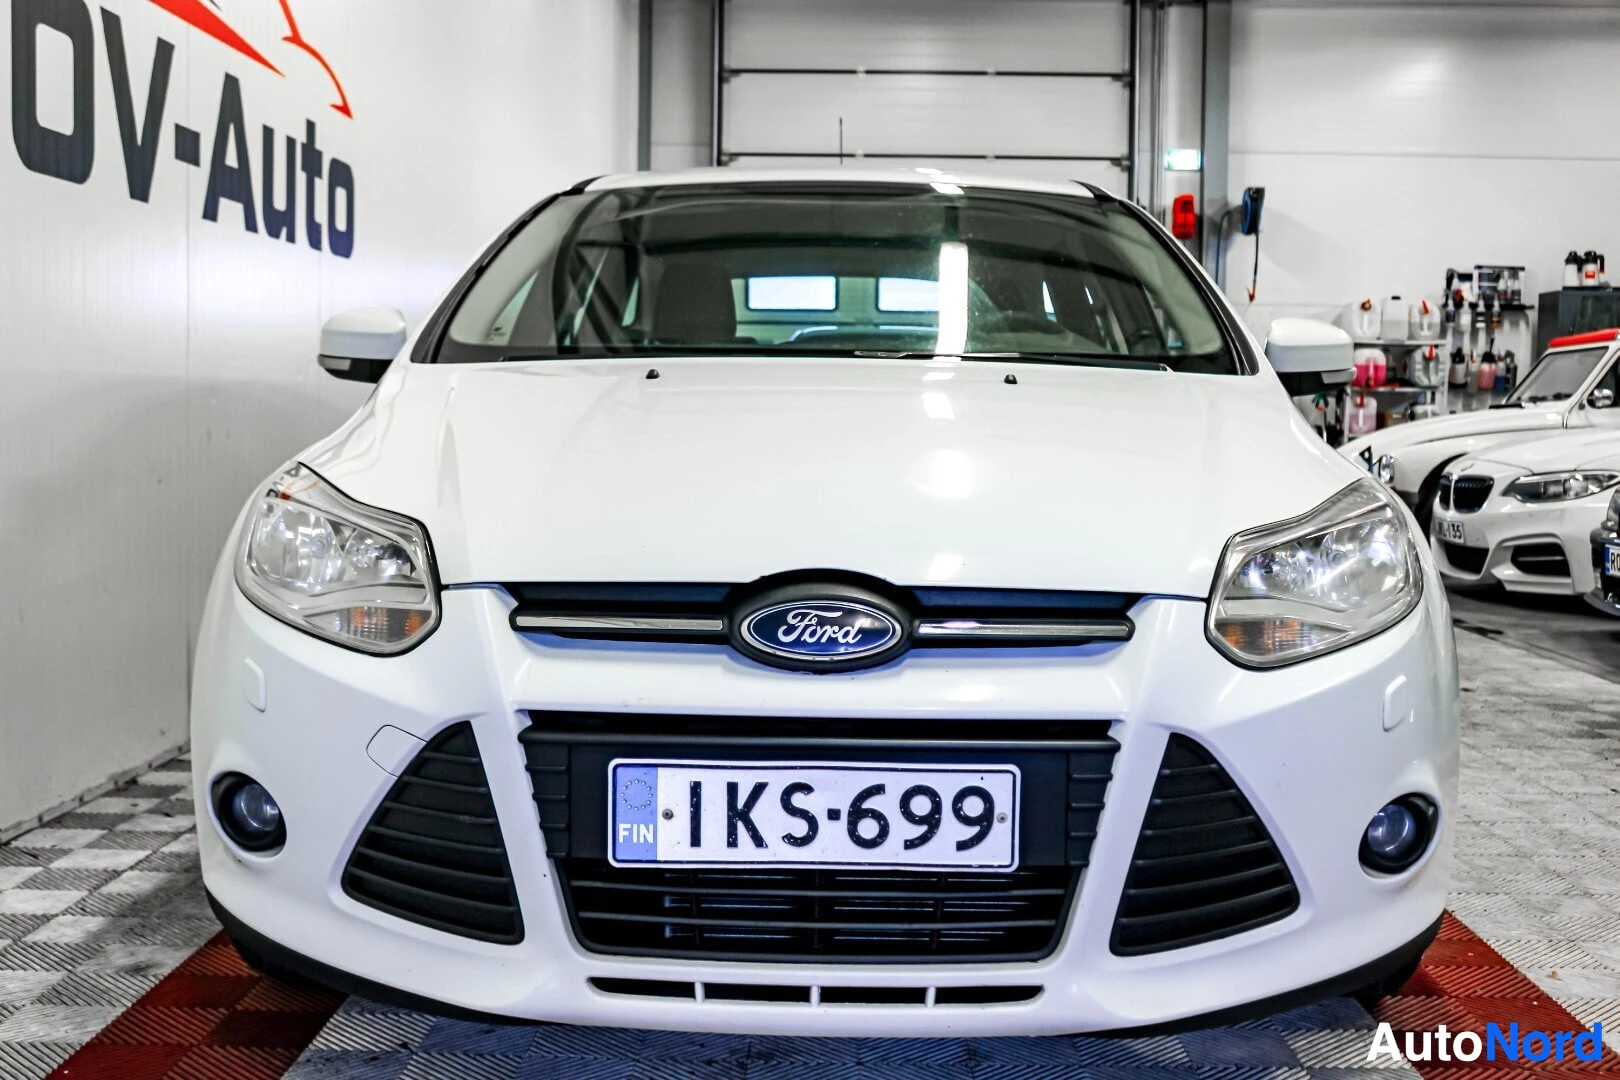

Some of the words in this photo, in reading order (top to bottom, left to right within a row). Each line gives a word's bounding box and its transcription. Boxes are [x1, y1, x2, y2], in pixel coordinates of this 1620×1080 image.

[11, 0, 354, 259] OV-Auto
[777, 609, 863, 644] Ford
[618, 823, 654, 844] FIN
[689, 780, 996, 852] IKS-699
